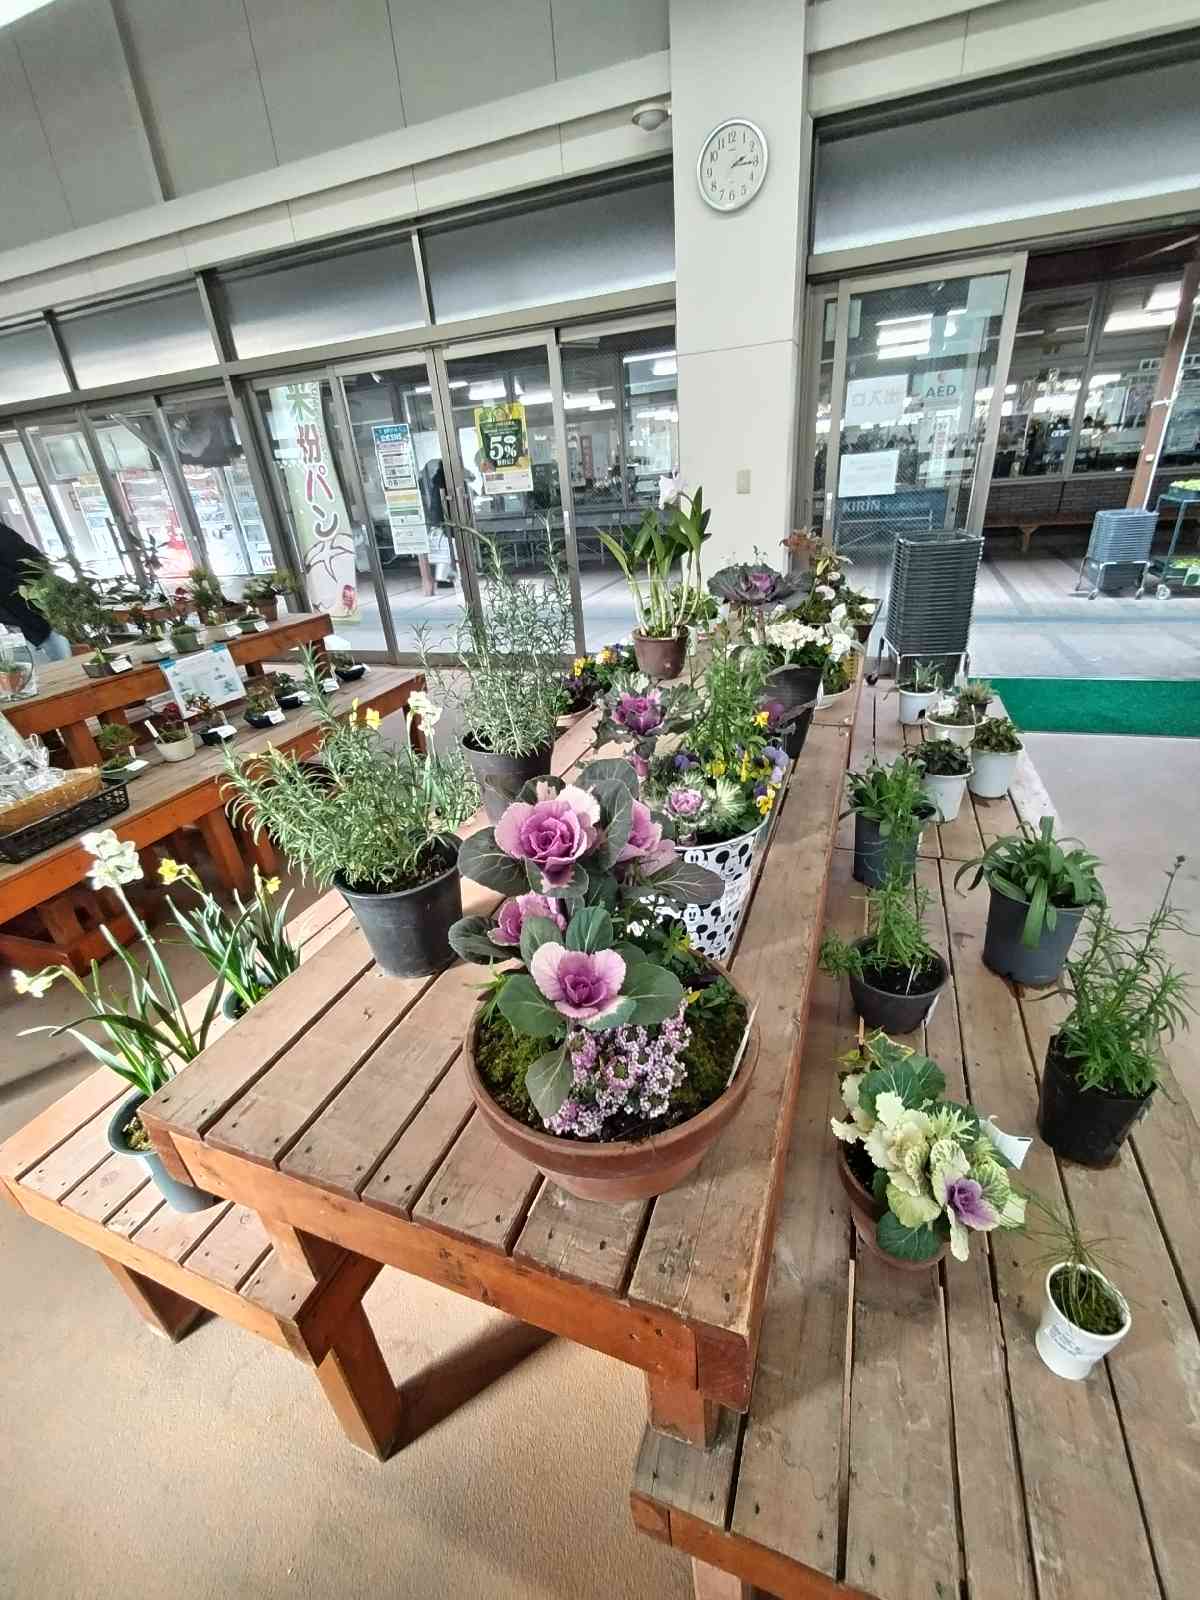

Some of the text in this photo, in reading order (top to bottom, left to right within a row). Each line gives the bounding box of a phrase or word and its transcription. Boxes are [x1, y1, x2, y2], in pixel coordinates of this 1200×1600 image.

[718, 138, 725, 150] 11
[728, 131, 737, 144] 12
[710, 151, 718, 163] 10
[926, 385, 957, 398] AED
[489, 436, 517, 460] 5%
[842, 498, 881, 512] KIRIN
